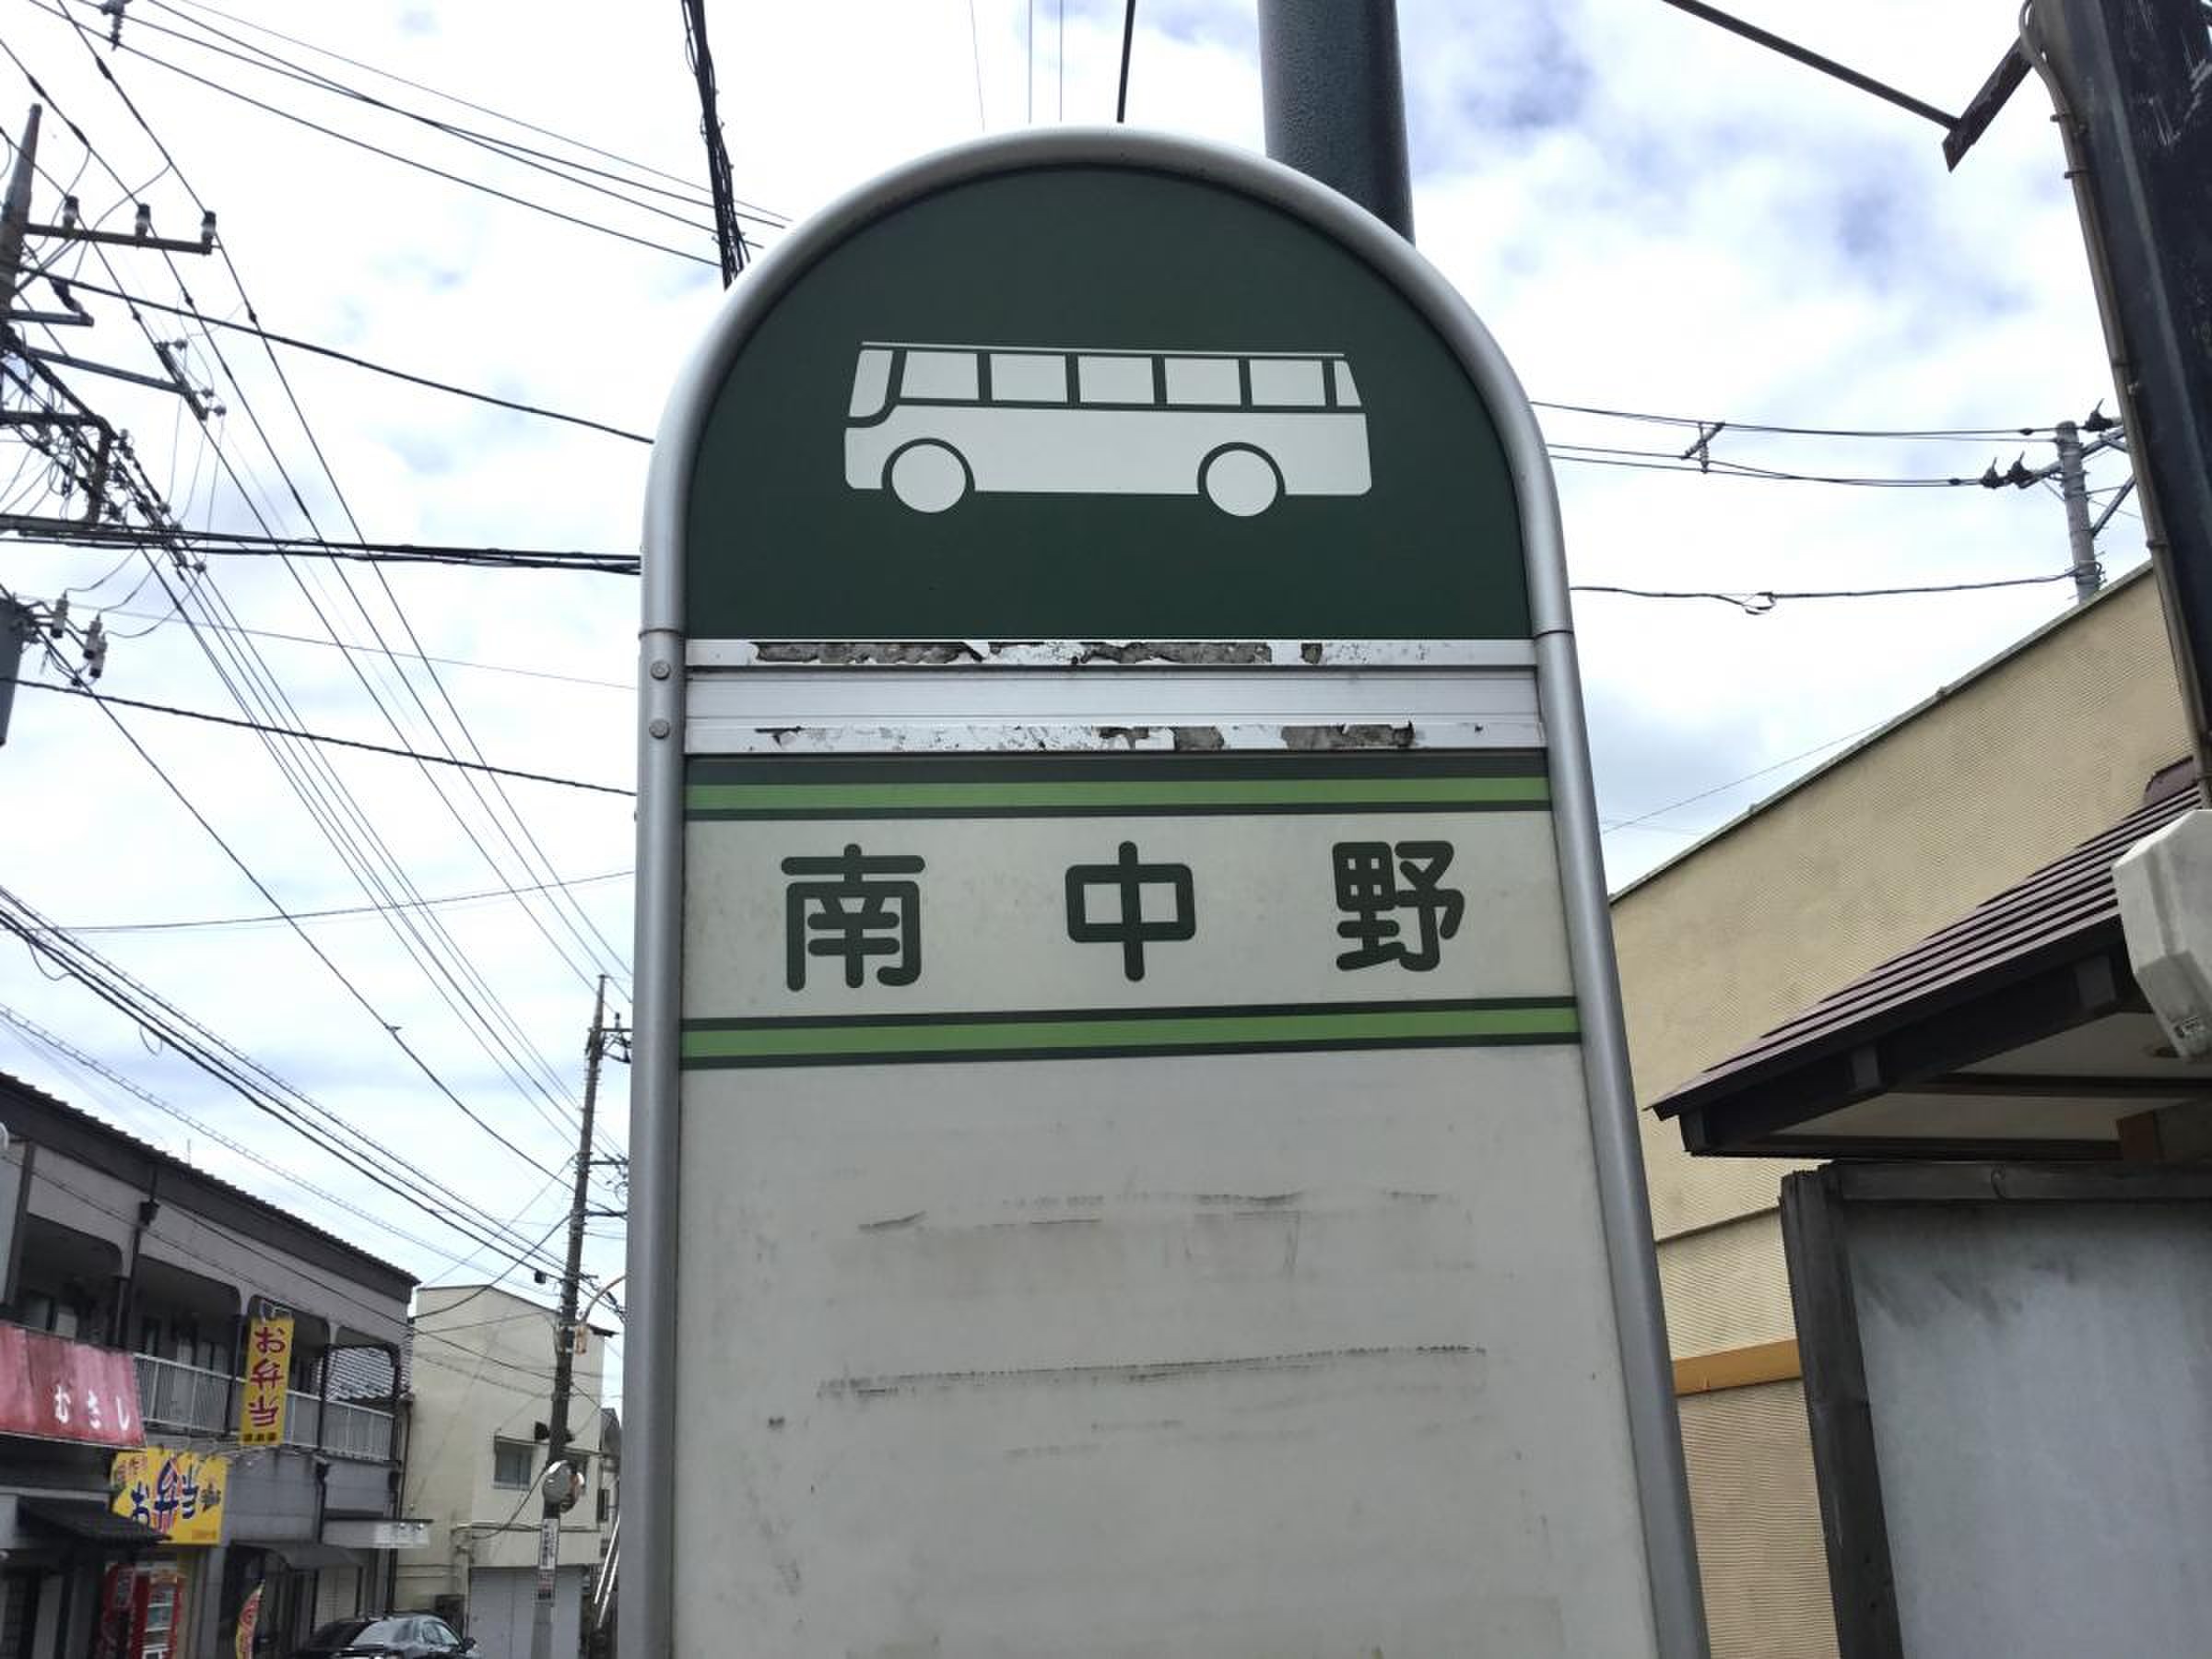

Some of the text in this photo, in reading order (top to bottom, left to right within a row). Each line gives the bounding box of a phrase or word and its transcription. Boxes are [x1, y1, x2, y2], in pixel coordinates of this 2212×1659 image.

[781, 840, 1465, 993] 南中野
[53, 1383, 131, 1431] むさし
[248, 1326, 287, 1427] お弁当
